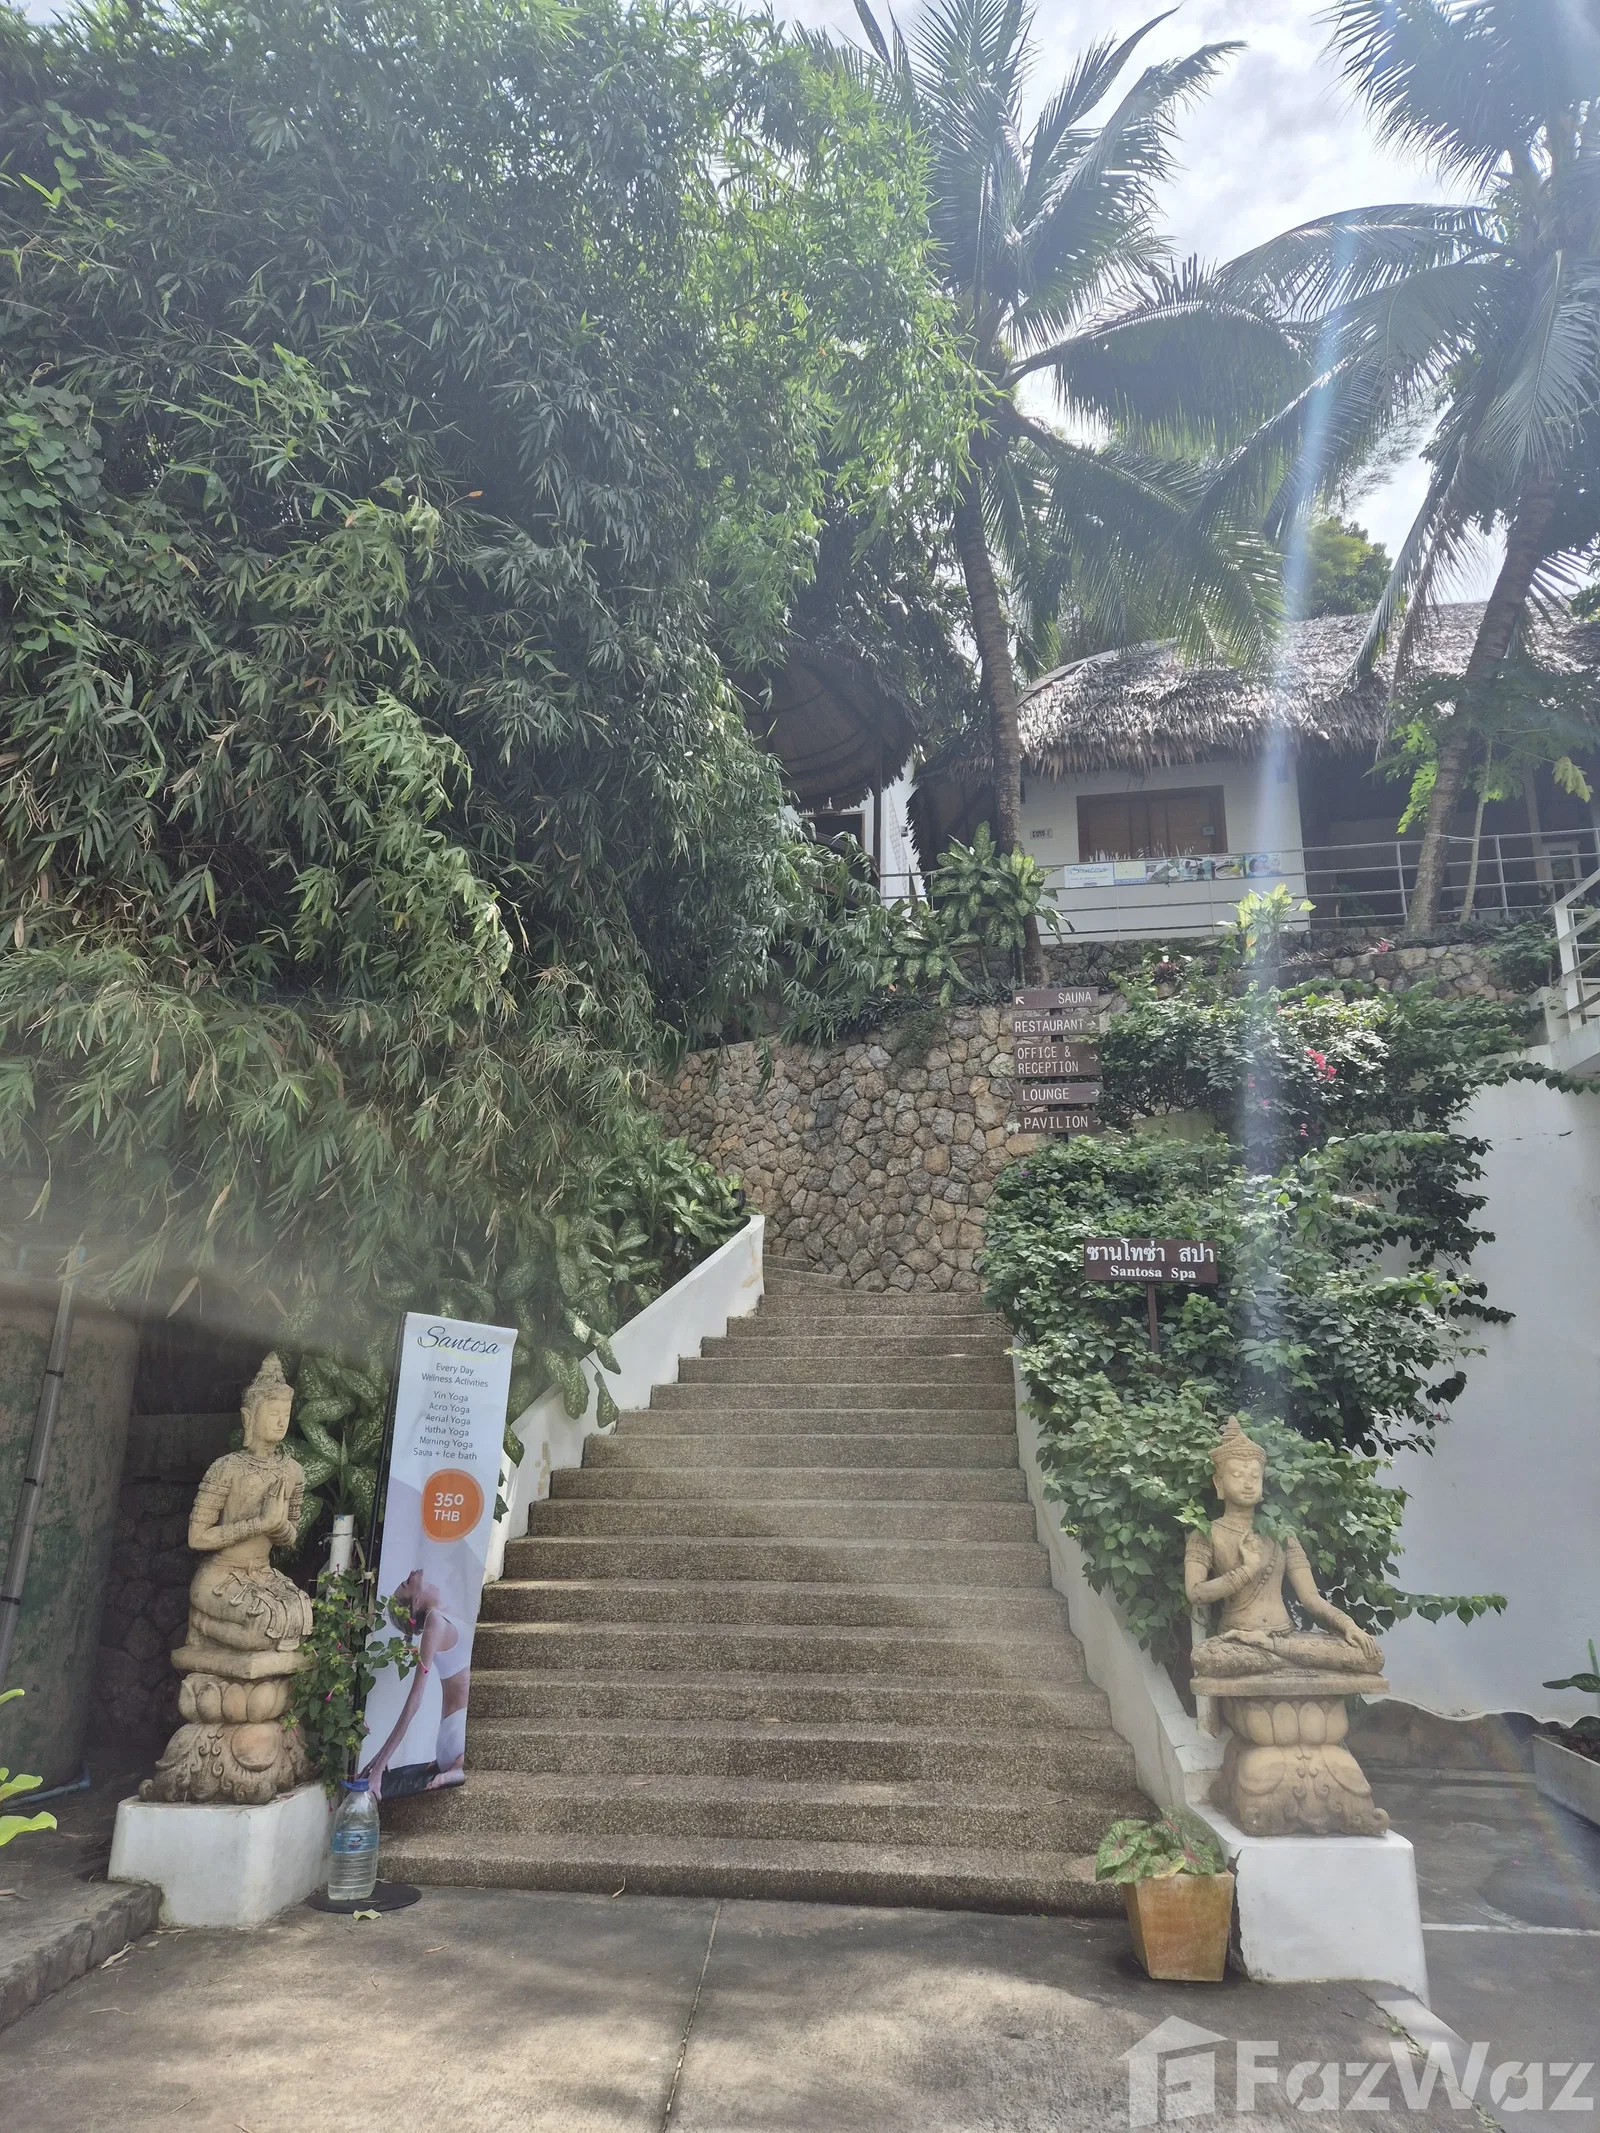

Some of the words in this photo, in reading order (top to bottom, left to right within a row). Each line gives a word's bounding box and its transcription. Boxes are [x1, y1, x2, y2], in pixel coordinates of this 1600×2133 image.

[1058, 991, 1092, 1004] SAUNA
[1014, 1019, 1083, 1033] RESTAURANT
[1017, 1046, 1057, 1059] OFFICE
[1064, 1046, 1071, 1057] &
[1018, 1061, 1079, 1074] RECEPTION
[1022, 1088, 1070, 1100] LOUNGE
[1024, 1115, 1088, 1129] PAVILION
[1086, 1238, 1165, 1261] ซานโทซ่า
[1179, 1243, 1214, 1263] สปา
[1110, 1265, 1162, 1278] Santosa
[1171, 1267, 1196, 1280] Spa
[417, 1326, 500, 1355] Santosa
[436, 1363, 458, 1375] Every
[460, 1366, 474, 1375] Day
[421, 1372, 453, 1383] Wellness
[454, 1377, 489, 1388] Activities
[433, 1390, 446, 1399] Yin
[448, 1392, 469, 1403] Yoga
[428, 1402, 448, 1411] Acro
[450, 1403, 470, 1415] Yoga
[425, 1413, 449, 1423] Aerial
[450, 1415, 471, 1426] Yoga
[425, 1425, 446, 1434] Hatha
[448, 1427, 469, 1438] Yoga
[420, 1436, 450, 1448] Morning
[452, 1439, 473, 1450] Yoga
[442, 1450, 456, 1458] Ice
[458, 1451, 478, 1460] bath
[434, 1492, 464, 1507] 350
[434, 1509, 460, 1522] THB
